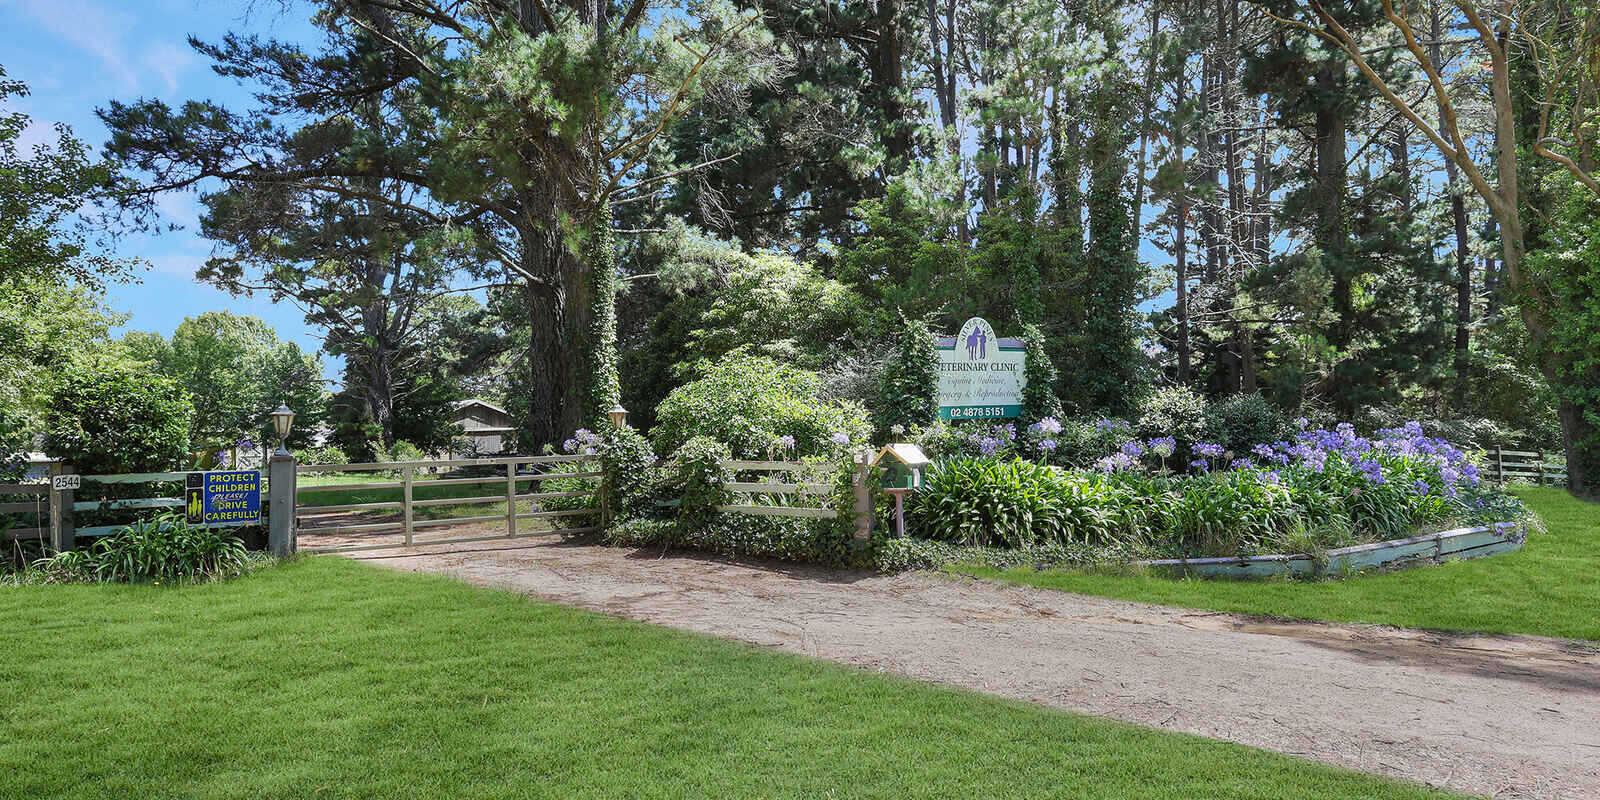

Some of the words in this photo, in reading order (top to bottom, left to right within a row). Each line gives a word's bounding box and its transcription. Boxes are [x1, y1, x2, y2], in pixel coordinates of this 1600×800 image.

[990, 362, 1019, 372] CLINIC
[946, 376, 971, 388] Equine
[937, 391, 962, 401] urgery
[950, 408, 961, 417] 02
[963, 408, 984, 416] 4878
[985, 407, 1004, 416] 5151
[55, 477, 79, 488] 2544
[209, 473, 255, 483] PROTECT
[208, 483, 256, 493] CHILDREN
[211, 492, 248, 502] PLEASE!
[218, 501, 248, 511] DRIVE
[205, 510, 259, 520] CAREFULLY
